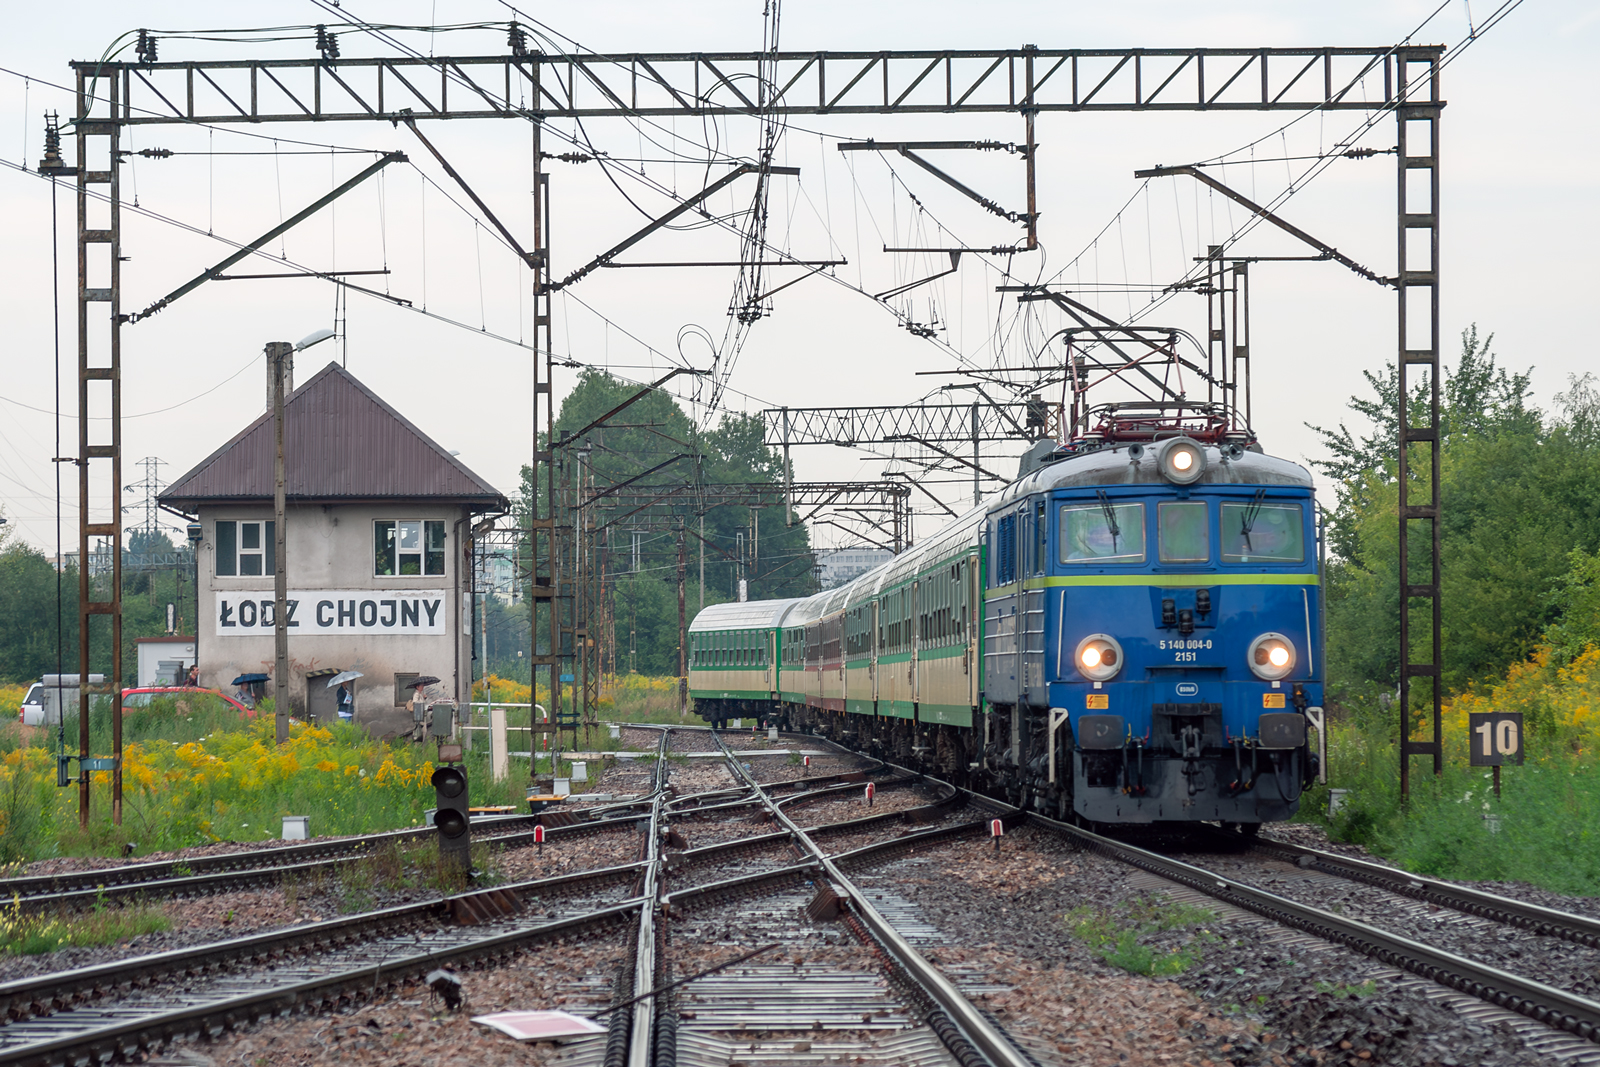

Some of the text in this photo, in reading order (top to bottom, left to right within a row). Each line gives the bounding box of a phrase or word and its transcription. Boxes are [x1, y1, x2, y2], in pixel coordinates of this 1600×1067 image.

[316, 599, 442, 627] CHOJNY
[1160, 640, 1212, 650] 5 140 004-0
[1175, 652, 1196, 661] 2151
[1475, 720, 1518, 755] 10
[93, 760, 101, 770] 11
